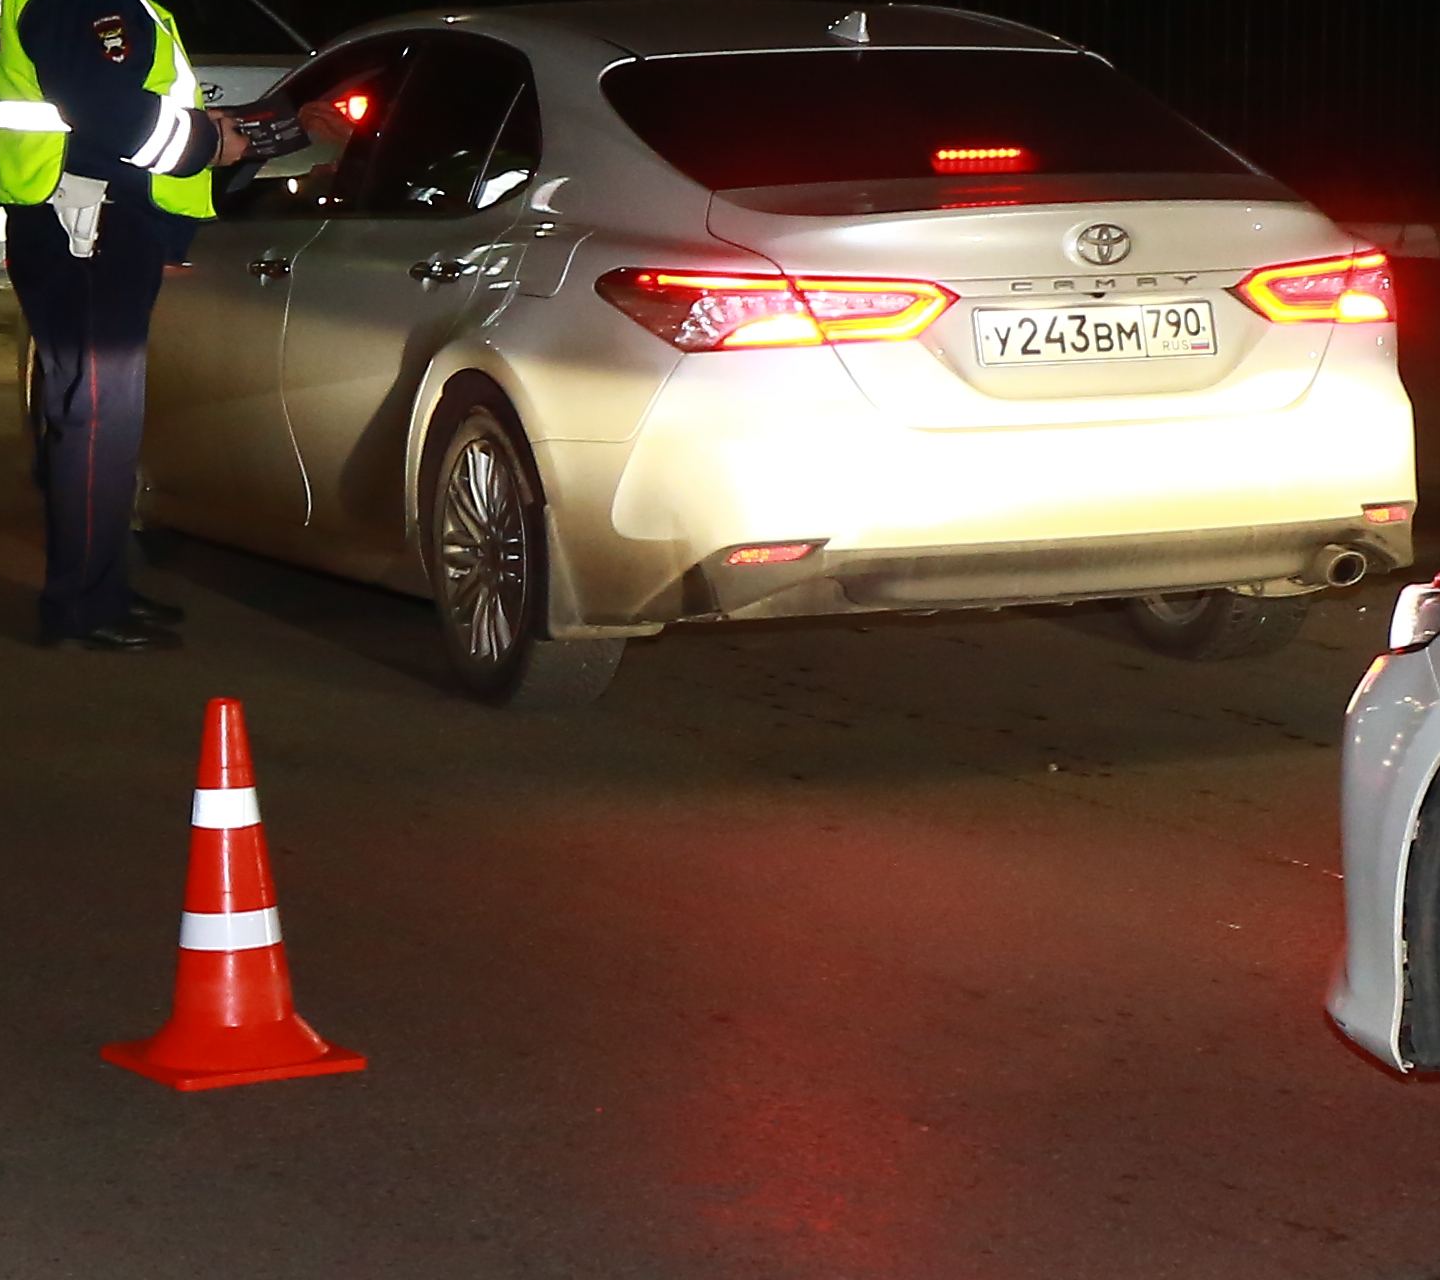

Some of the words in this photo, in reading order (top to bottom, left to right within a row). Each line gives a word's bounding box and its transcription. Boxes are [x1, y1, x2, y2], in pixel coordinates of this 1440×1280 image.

[1011, 275, 1197, 291] CAMRY
[994, 314, 1142, 357] У243ВМ
[1146, 307, 1201, 339] 790
[1162, 340, 1189, 351] RUS
